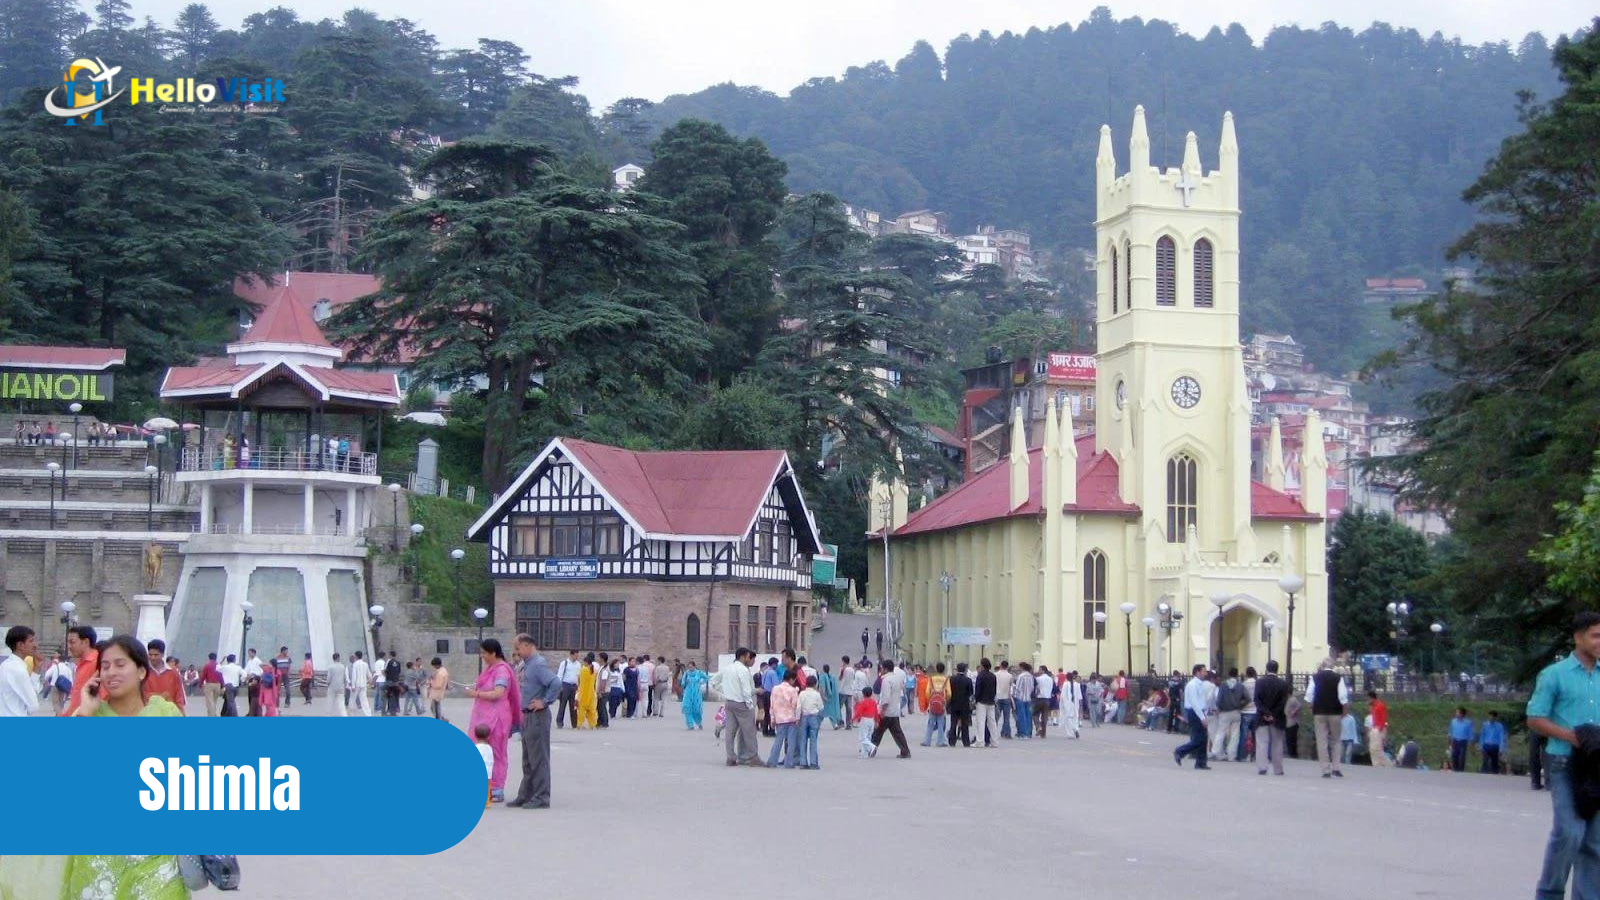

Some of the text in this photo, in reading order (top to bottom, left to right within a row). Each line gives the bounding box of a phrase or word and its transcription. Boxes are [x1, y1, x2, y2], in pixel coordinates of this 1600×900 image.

[1050, 353, 1096, 369] अमर उजाल
[2, 372, 105, 401] IANOIL
